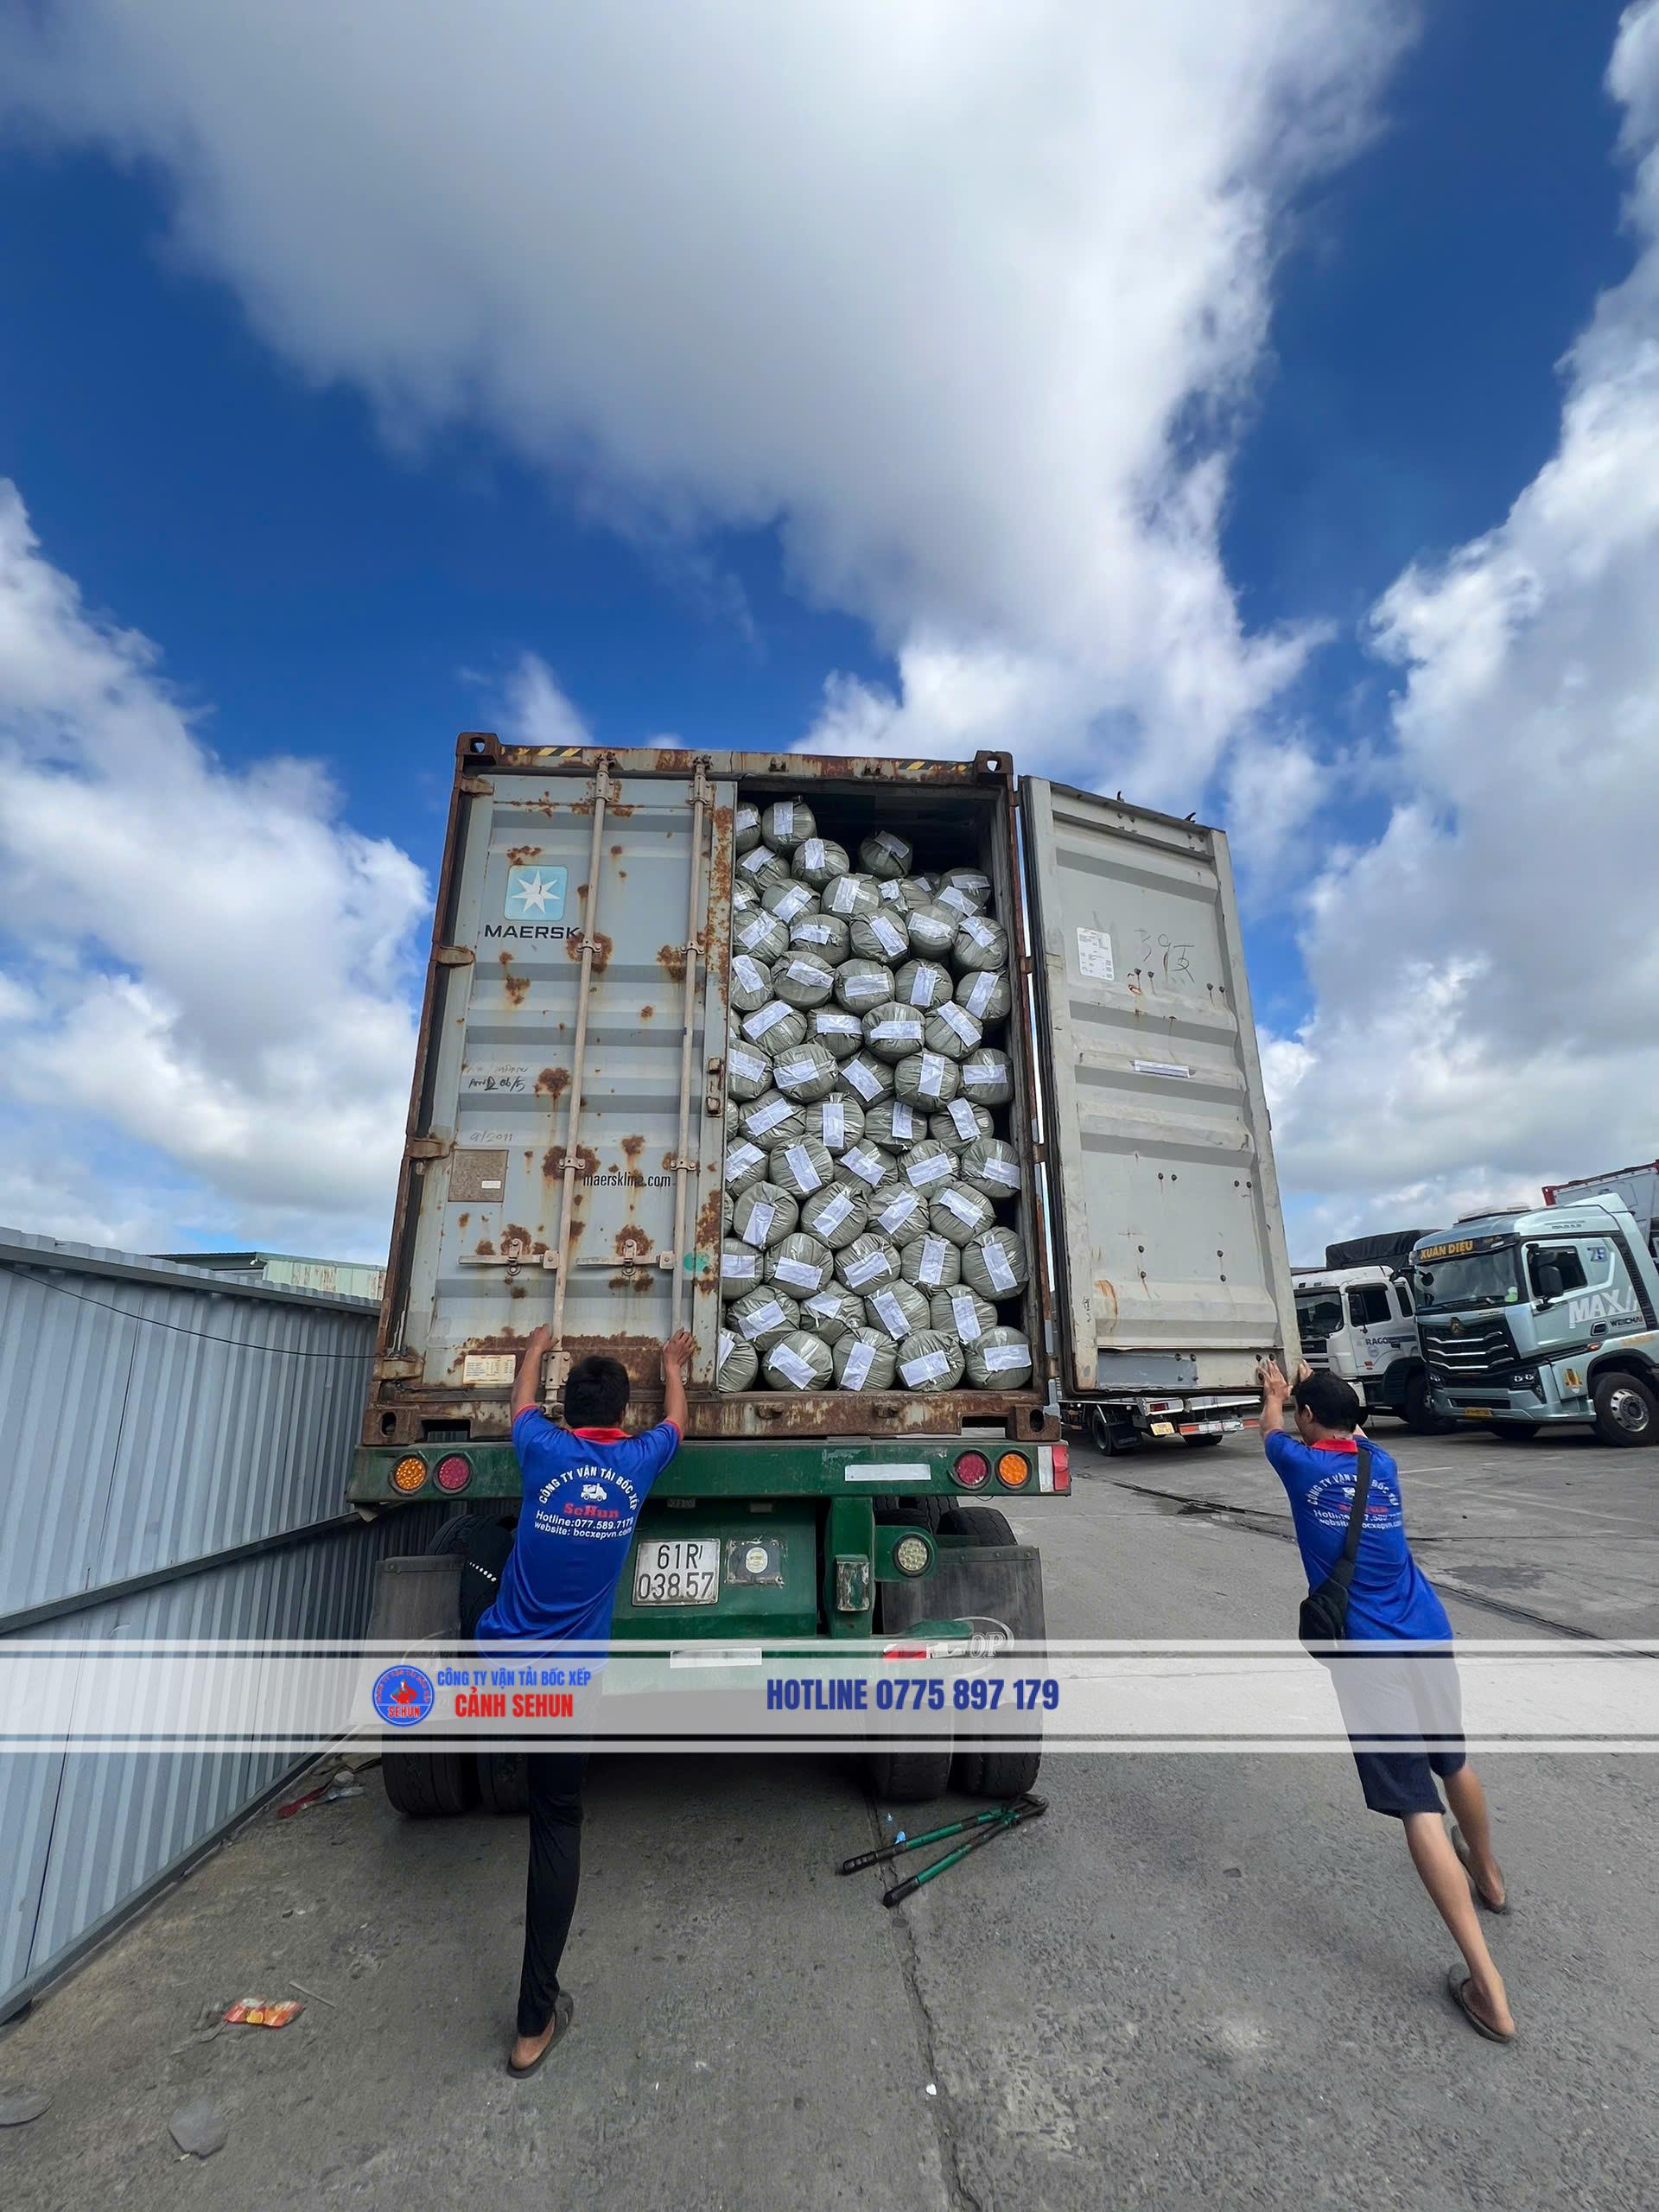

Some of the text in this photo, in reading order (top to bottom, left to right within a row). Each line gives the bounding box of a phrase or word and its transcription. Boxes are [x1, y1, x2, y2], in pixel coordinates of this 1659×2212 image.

[484, 924, 581, 939] MAERSK
[582, 1171, 671, 1187] maersklin.com
[560, 1470, 574, 1483] TY
[576, 1465, 597, 1478] VẬN
